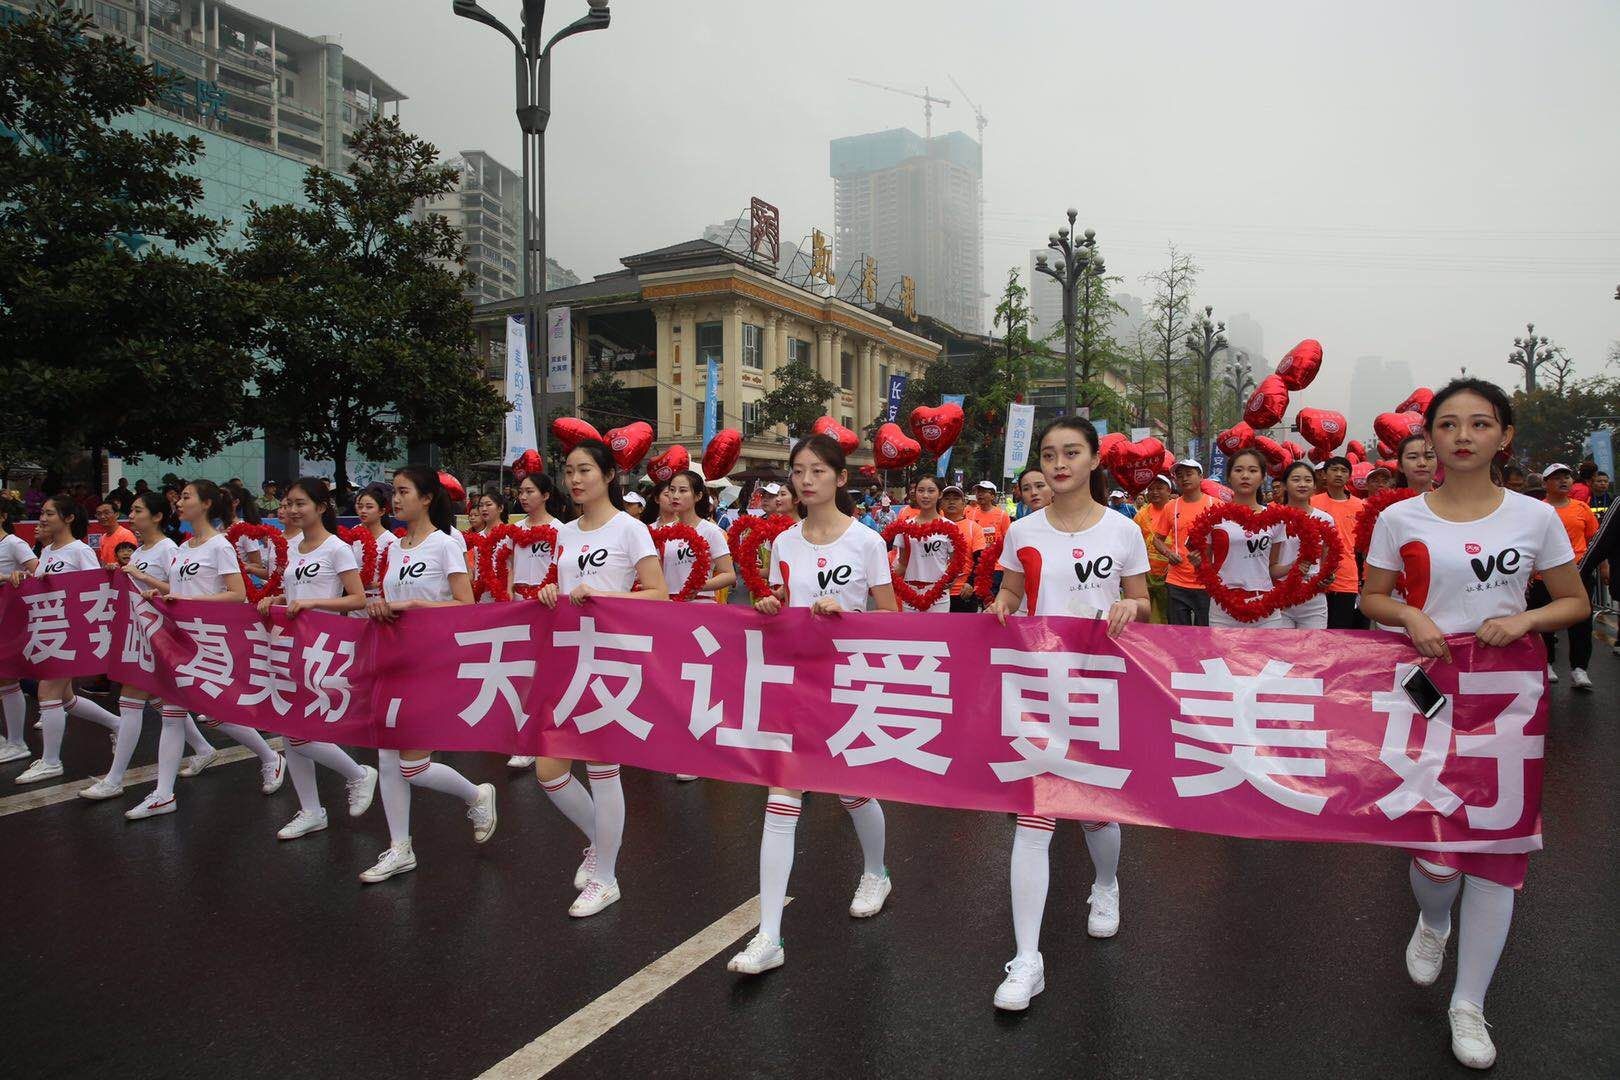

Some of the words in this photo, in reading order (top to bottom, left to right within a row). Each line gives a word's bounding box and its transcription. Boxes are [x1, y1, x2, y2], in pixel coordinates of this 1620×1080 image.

[532, 541, 551, 553] ve
[924, 540, 941, 553] ve
[1247, 536, 1269, 553] ve
[45, 560, 64, 573] ve
[578, 549, 608, 570] ve
[1471, 548, 1520, 582] ve
[180, 562, 201, 577] ve
[295, 563, 320, 580] ve
[400, 561, 426, 580] ve
[817, 565, 851, 589] ve
[1075, 556, 1112, 583] ve
